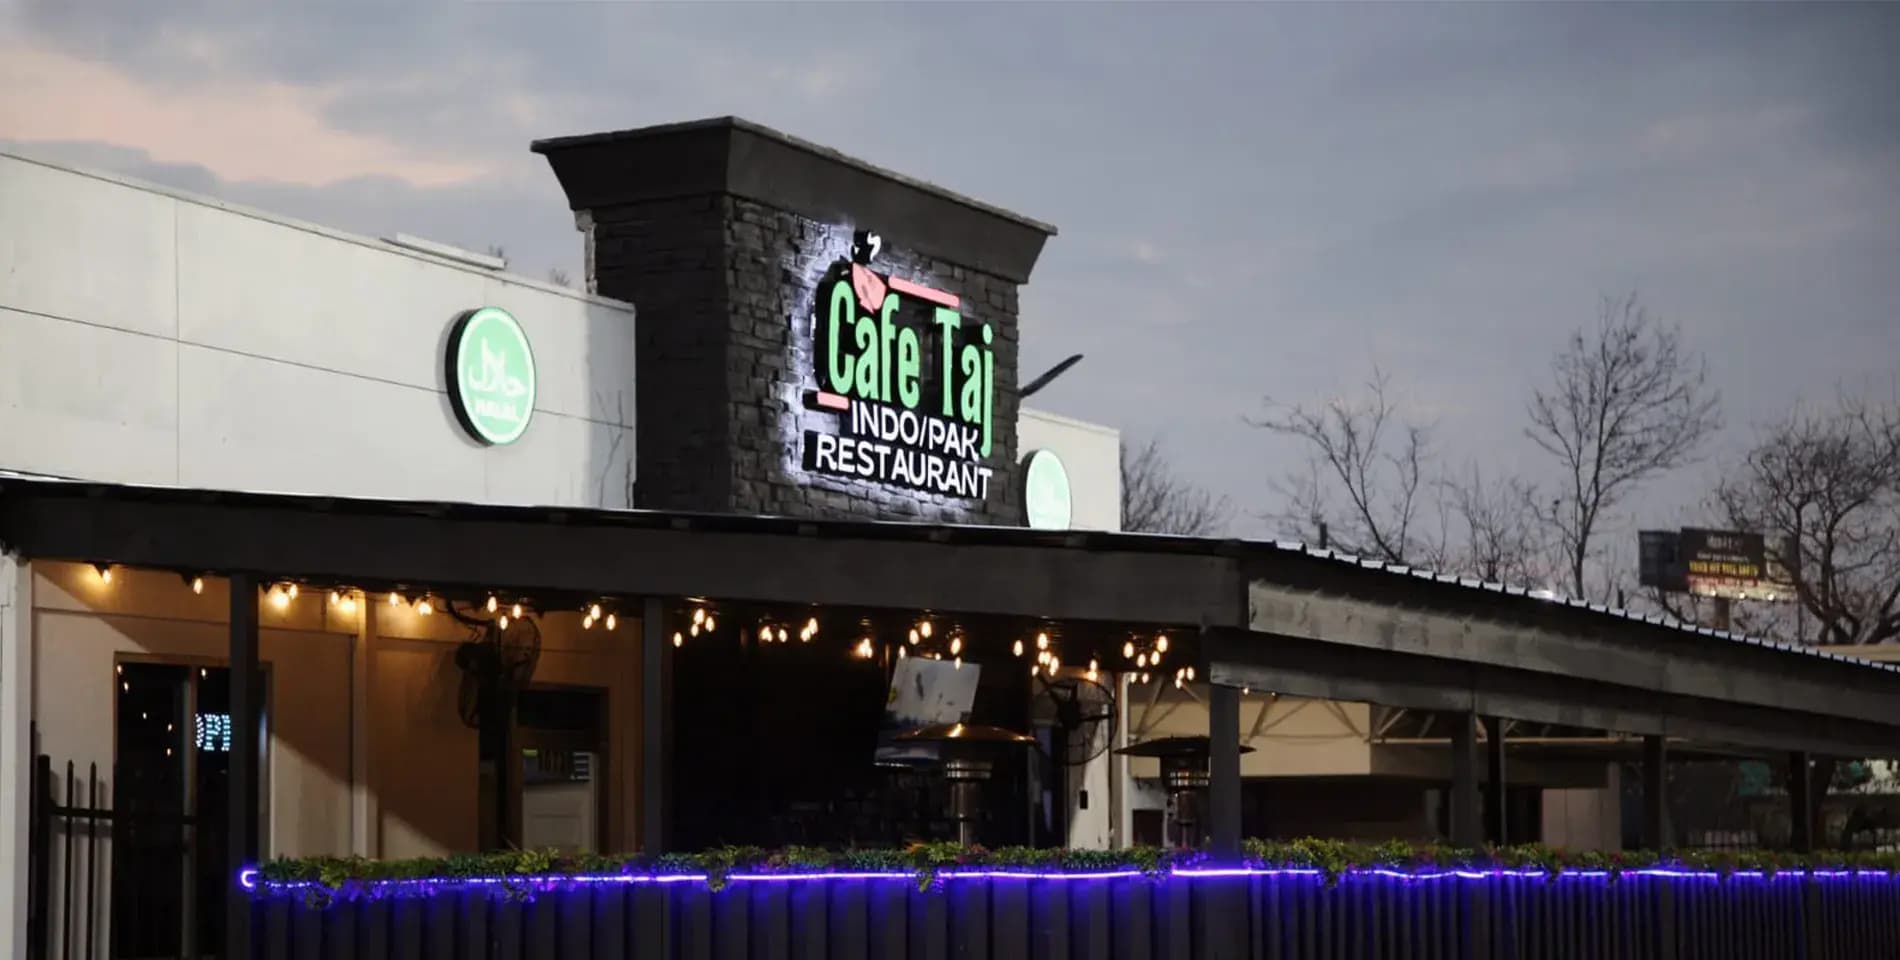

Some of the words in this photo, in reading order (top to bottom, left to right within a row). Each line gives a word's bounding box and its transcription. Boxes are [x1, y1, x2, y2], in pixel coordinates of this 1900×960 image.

[829, 281, 920, 409] Cafe
[935, 307, 993, 457] Taj
[852, 400, 980, 461] INDO/PAK
[816, 434, 993, 500] RESTAURANT
